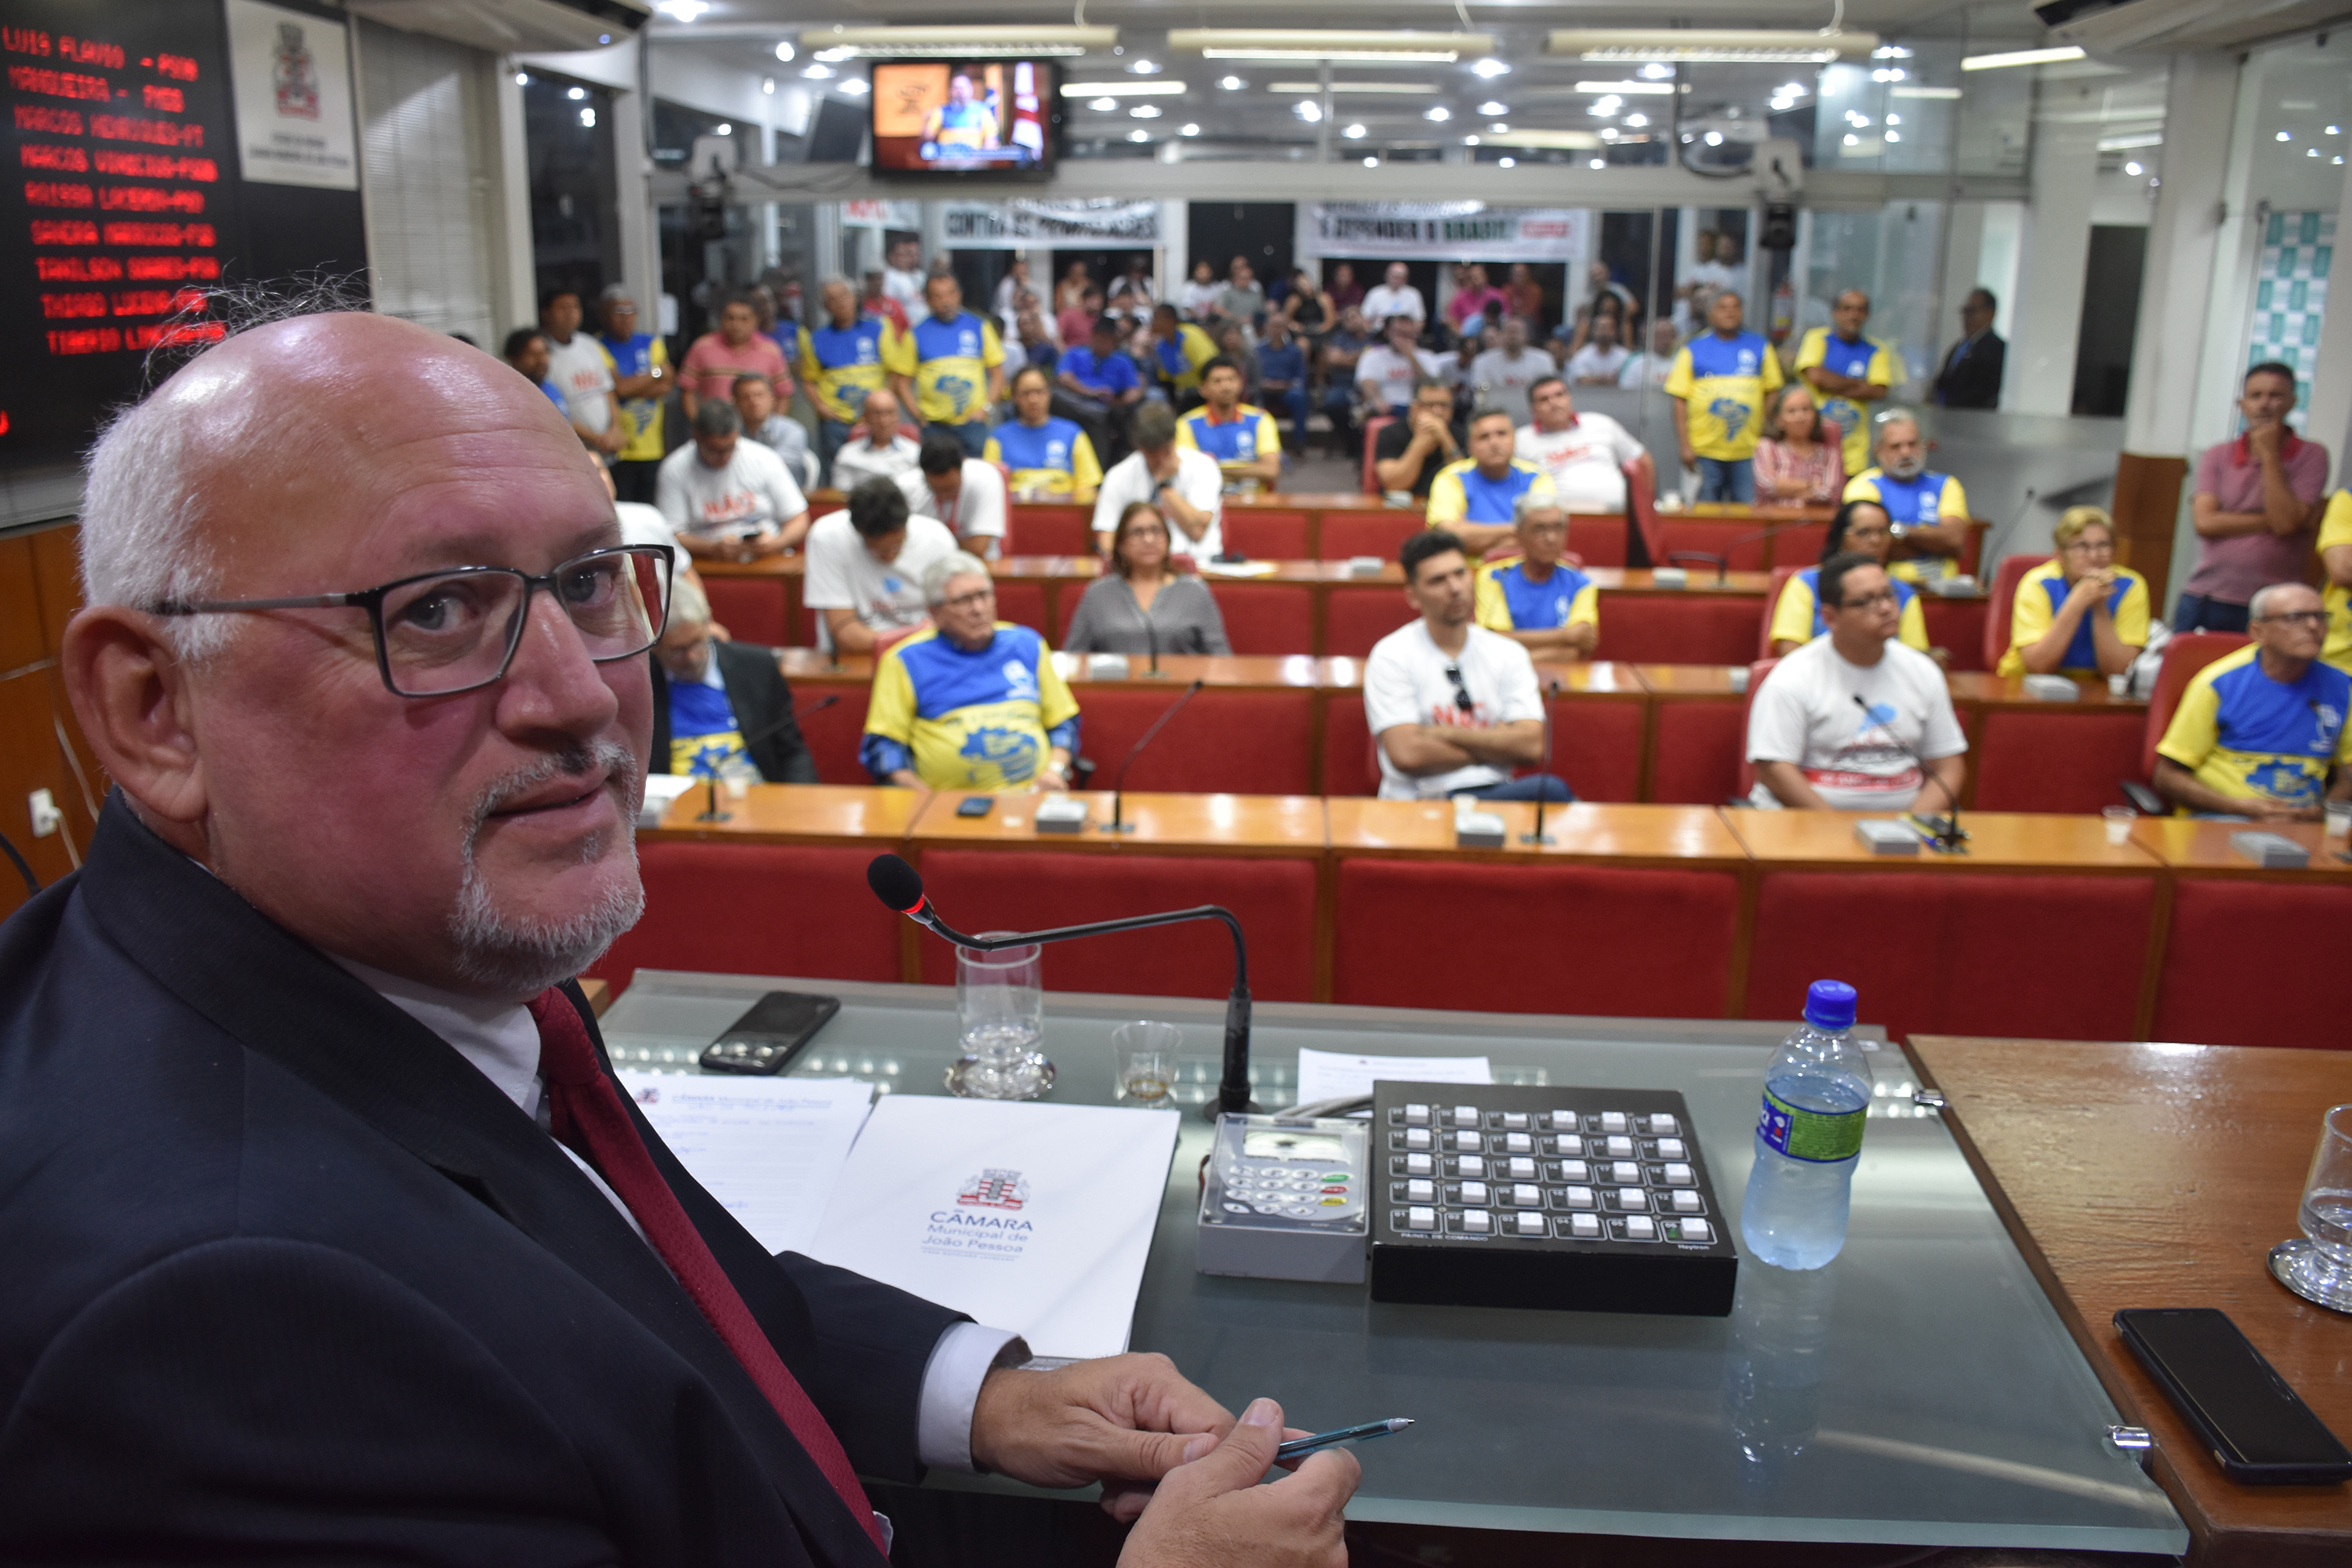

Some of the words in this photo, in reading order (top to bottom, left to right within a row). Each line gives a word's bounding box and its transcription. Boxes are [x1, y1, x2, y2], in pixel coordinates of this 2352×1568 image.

[927, 1225, 1004, 1240] Municipal
[1007, 1233, 1028, 1243] de
[922, 1235, 963, 1247] João
[967, 1239, 1023, 1253] Pessoa
